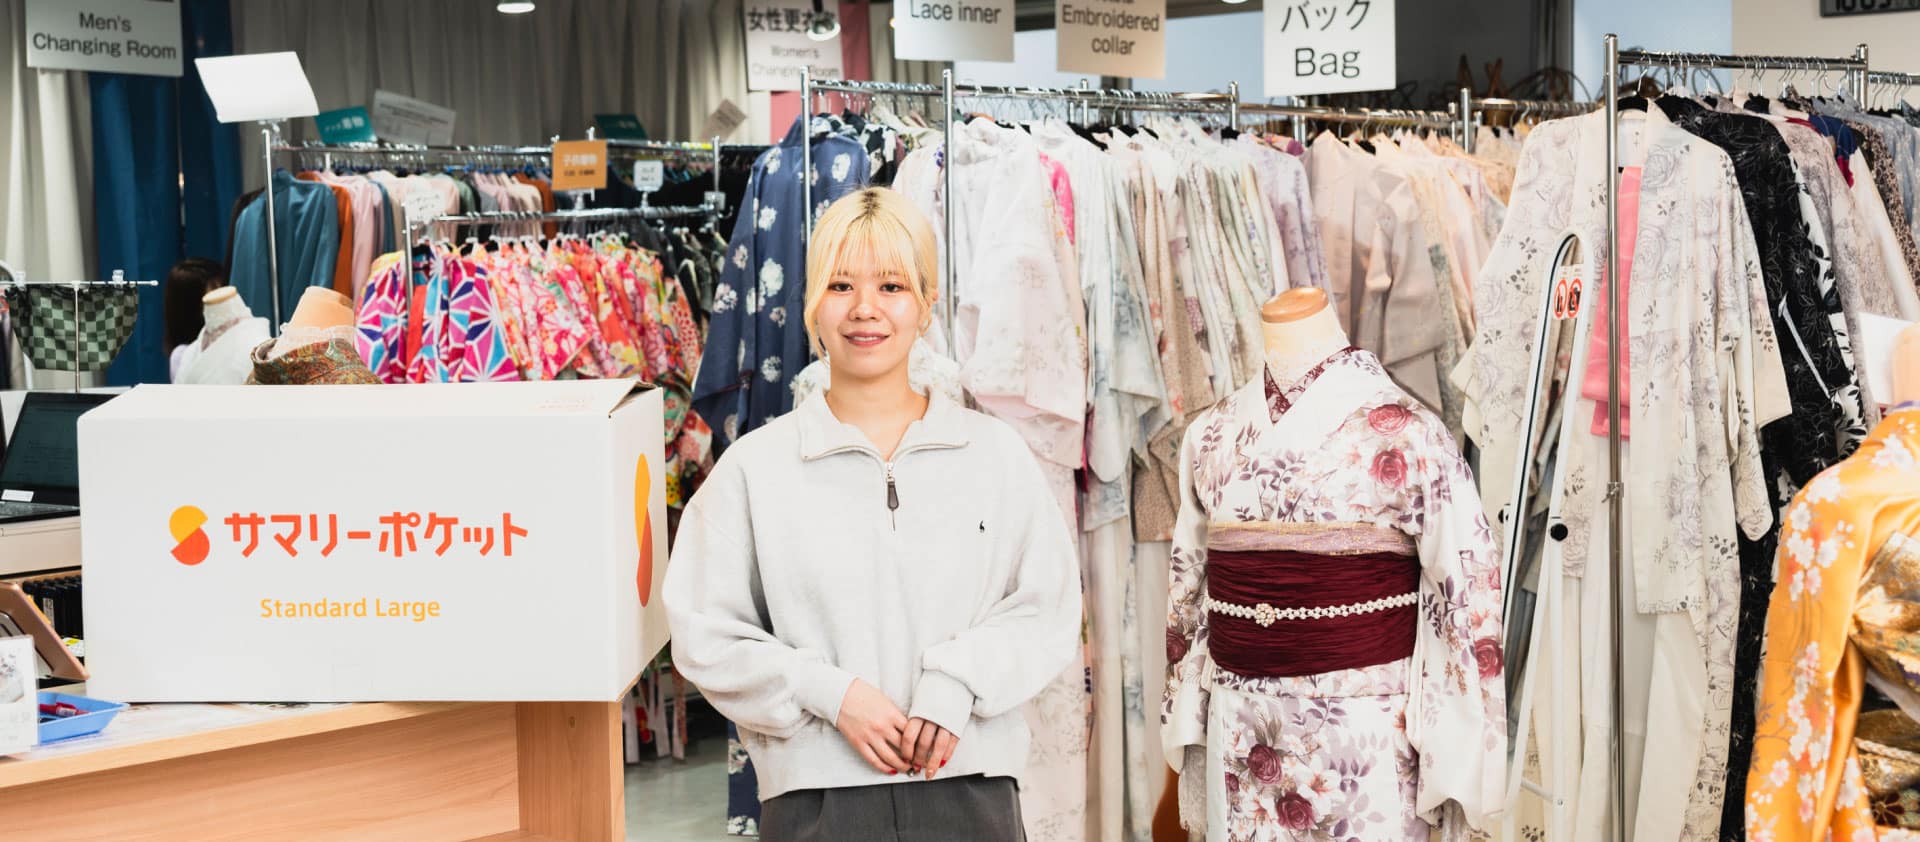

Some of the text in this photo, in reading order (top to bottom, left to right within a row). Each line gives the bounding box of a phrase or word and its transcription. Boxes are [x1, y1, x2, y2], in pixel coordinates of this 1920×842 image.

[79, 12, 132, 32] Men's
[911, 0, 1002, 24] Lace inner
[1062, 4, 1160, 32] Embroidered
[1281, 0, 1370, 32] バック
[33, 32, 177, 59] Changing Room
[771, 45, 820, 58] Women's
[1091, 35, 1136, 55] collar
[1295, 47, 1360, 78] Bag
[224, 512, 528, 557] サマリーポケット
[260, 597, 441, 622] Standard Large
